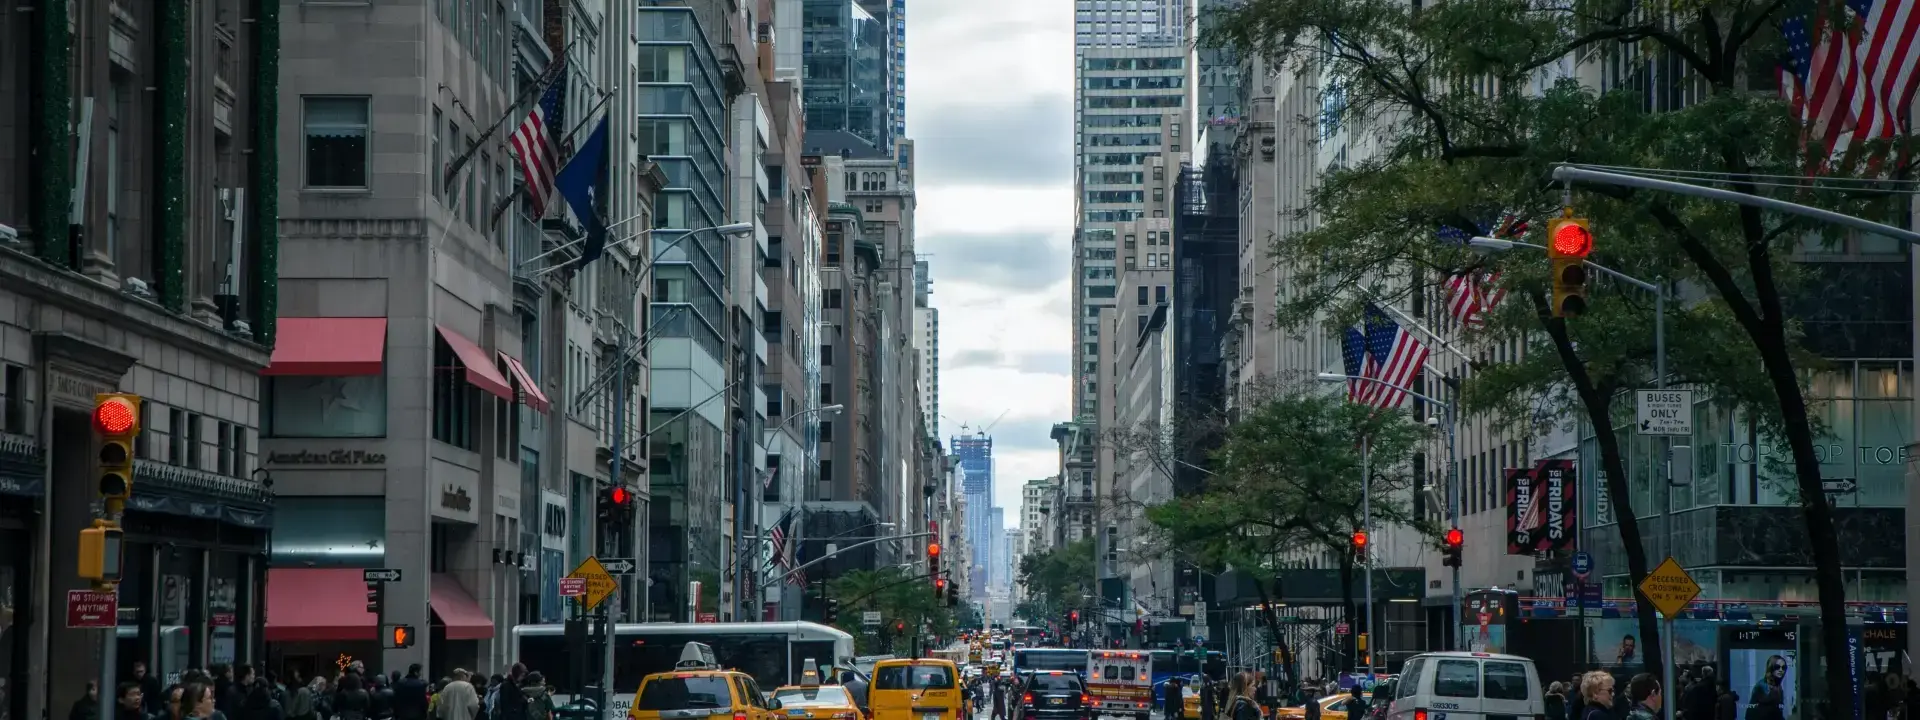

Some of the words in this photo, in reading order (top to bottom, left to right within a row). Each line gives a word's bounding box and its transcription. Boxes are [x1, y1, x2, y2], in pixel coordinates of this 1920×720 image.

[1647, 393, 1681, 402] BUSES
[1651, 409, 1678, 418] ONLY
[267, 449, 327, 464] American
[329, 449, 351, 464] Girl
[353, 449, 386, 464] Place
[1721, 442, 1844, 464] TOPSOP
[1548, 477, 1563, 540] FRIDAYS
[1517, 486, 1531, 544] FRIDS
[545, 502, 566, 538] ALDO
[1651, 575, 1688, 584] RECESSED
[1648, 584, 1691, 593] CROSSWALK
[71, 594, 81, 602] NO
[83, 593, 115, 602] STOPPING
[76, 604, 109, 612] ANYTIME
[612, 701, 632, 709] BAL
[1433, 702, 1459, 710] 6933015
